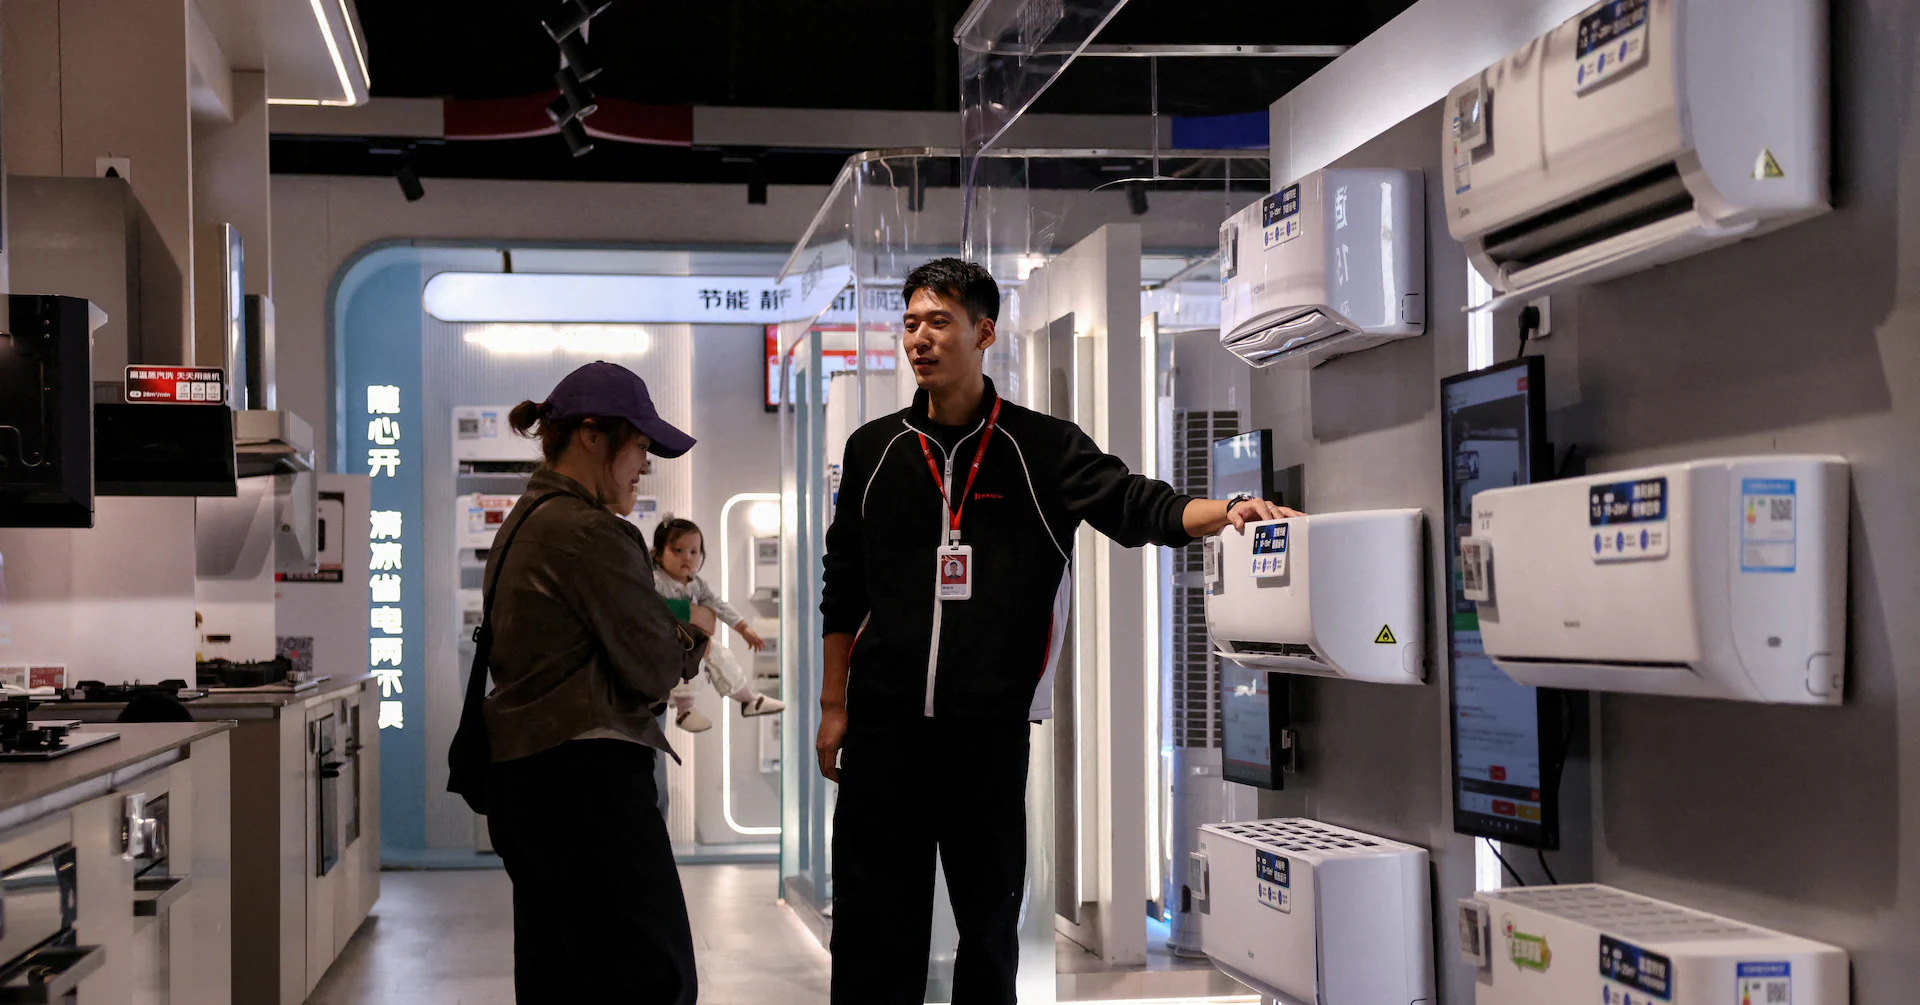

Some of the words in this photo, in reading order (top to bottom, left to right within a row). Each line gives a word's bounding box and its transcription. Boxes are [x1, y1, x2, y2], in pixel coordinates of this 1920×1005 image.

[699, 289, 749, 310] 节能
[130, 371, 174, 380] 高温蒸汽洗
[177, 371, 220, 381] 天天用新机
[367, 385, 401, 477] 随心开
[369, 510, 403, 729] 清凉省电两不误
